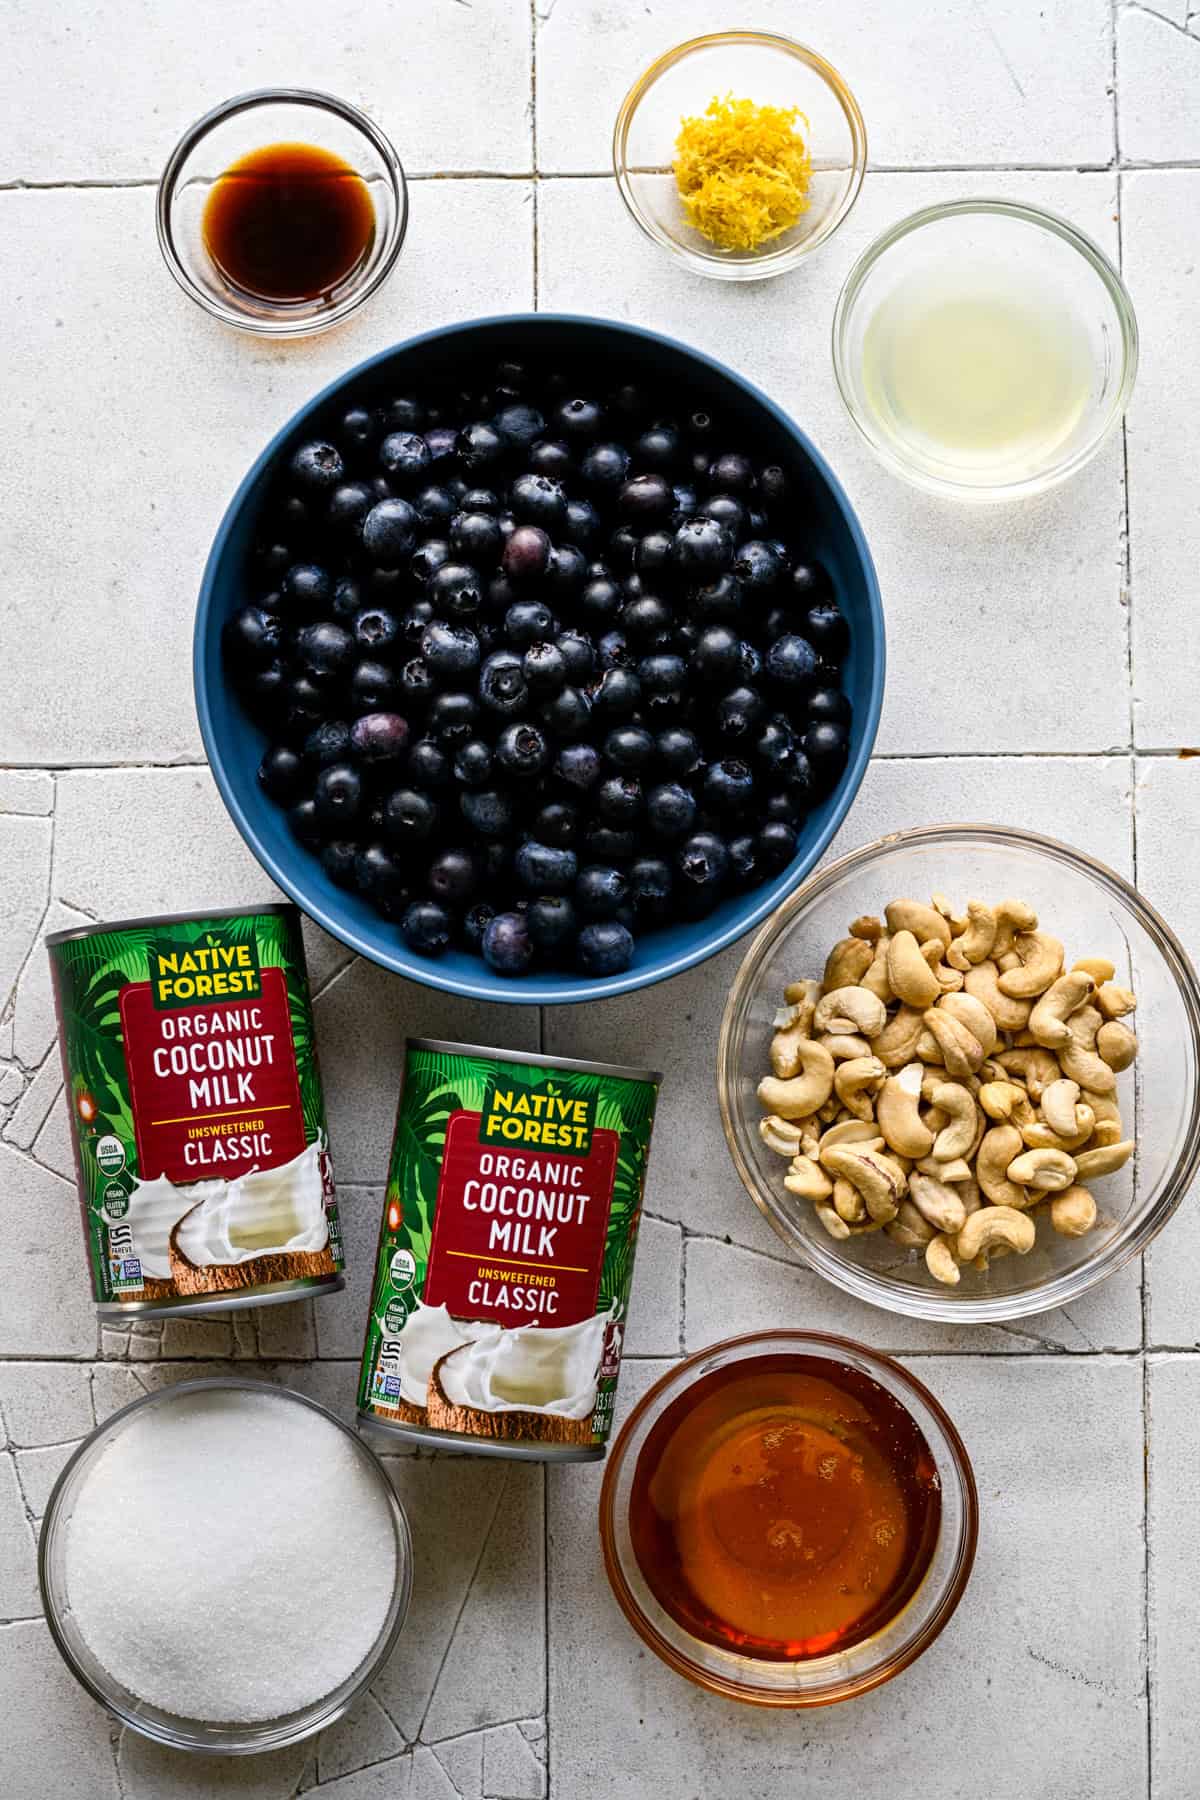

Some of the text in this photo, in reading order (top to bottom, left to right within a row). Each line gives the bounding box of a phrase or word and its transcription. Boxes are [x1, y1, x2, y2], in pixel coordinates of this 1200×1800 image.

[158, 945, 252, 976] NATIVE
[158, 970, 256, 1001] FOREST
[161, 1008, 263, 1040] ORGANIC
[153, 1035, 275, 1078] COCONUT
[188, 1072, 256, 1109] MILK
[492, 1089, 588, 1123] NATIVE
[188, 1120, 265, 1139] UNSWEETENED
[486, 1114, 588, 1148] FOREST
[101, 1143, 118, 1155] USDA
[183, 1133, 273, 1166] CLASSIC
[480, 1153, 583, 1187] ORGANIC
[106, 1189, 124, 1199] VEGAN
[463, 1180, 591, 1224] COCONUT
[110, 1209, 123, 1218] FREE
[489, 1219, 558, 1257] MILK
[478, 1267, 556, 1288] UNSWEETENED
[468, 1281, 560, 1314] CLASSIC
